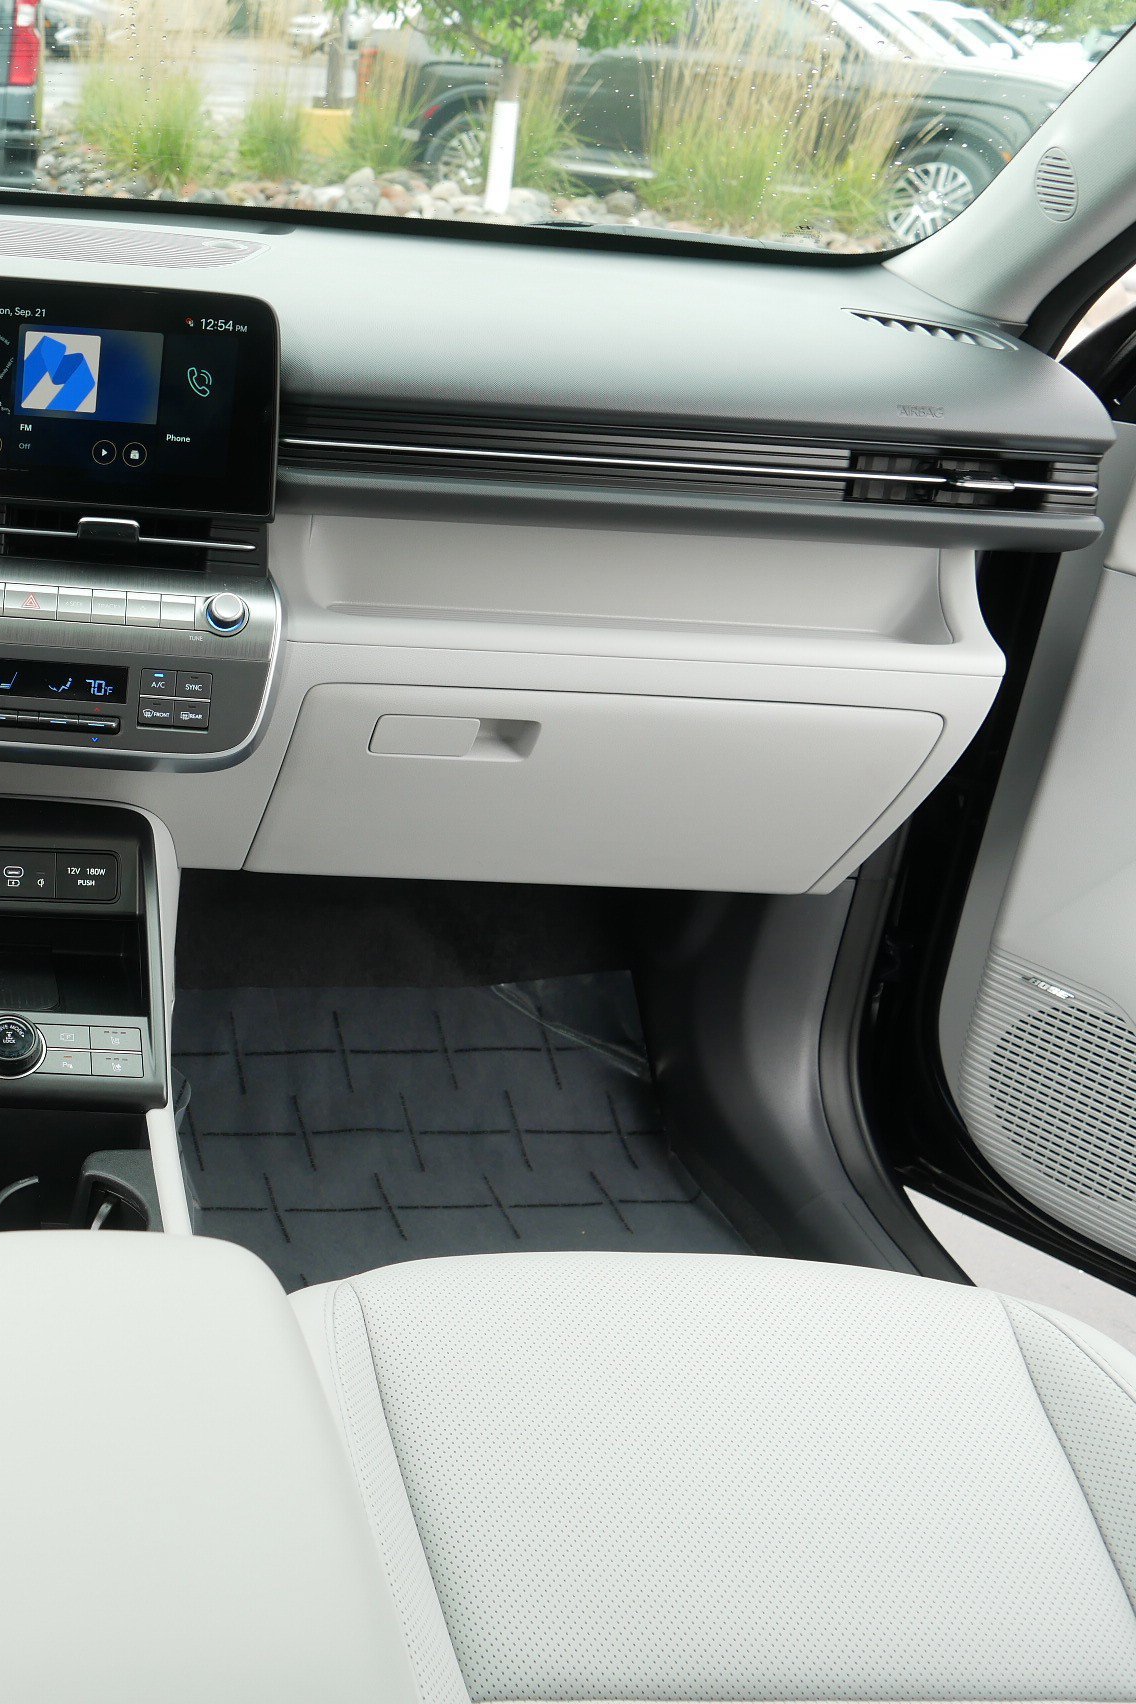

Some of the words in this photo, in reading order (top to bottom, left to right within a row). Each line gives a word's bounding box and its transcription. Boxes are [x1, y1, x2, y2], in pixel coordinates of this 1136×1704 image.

[14, 307, 34, 318] Sep.
[35, 309, 47, 317] 21
[200, 318, 233, 331] 12:54
[235, 324, 248, 333] PM
[898, 405, 945, 419] AIRBAG
[19, 423, 33, 432] FM
[166, 433, 191, 443] Phone
[18, 442, 31, 450] Off
[150, 680, 166, 690] A/C
[184, 683, 203, 693] SYNC
[152, 711, 170, 719] FRONT
[66, 867, 81, 875] 12V
[86, 868, 106, 876] 180W
[77, 878, 96, 887] PUSH
